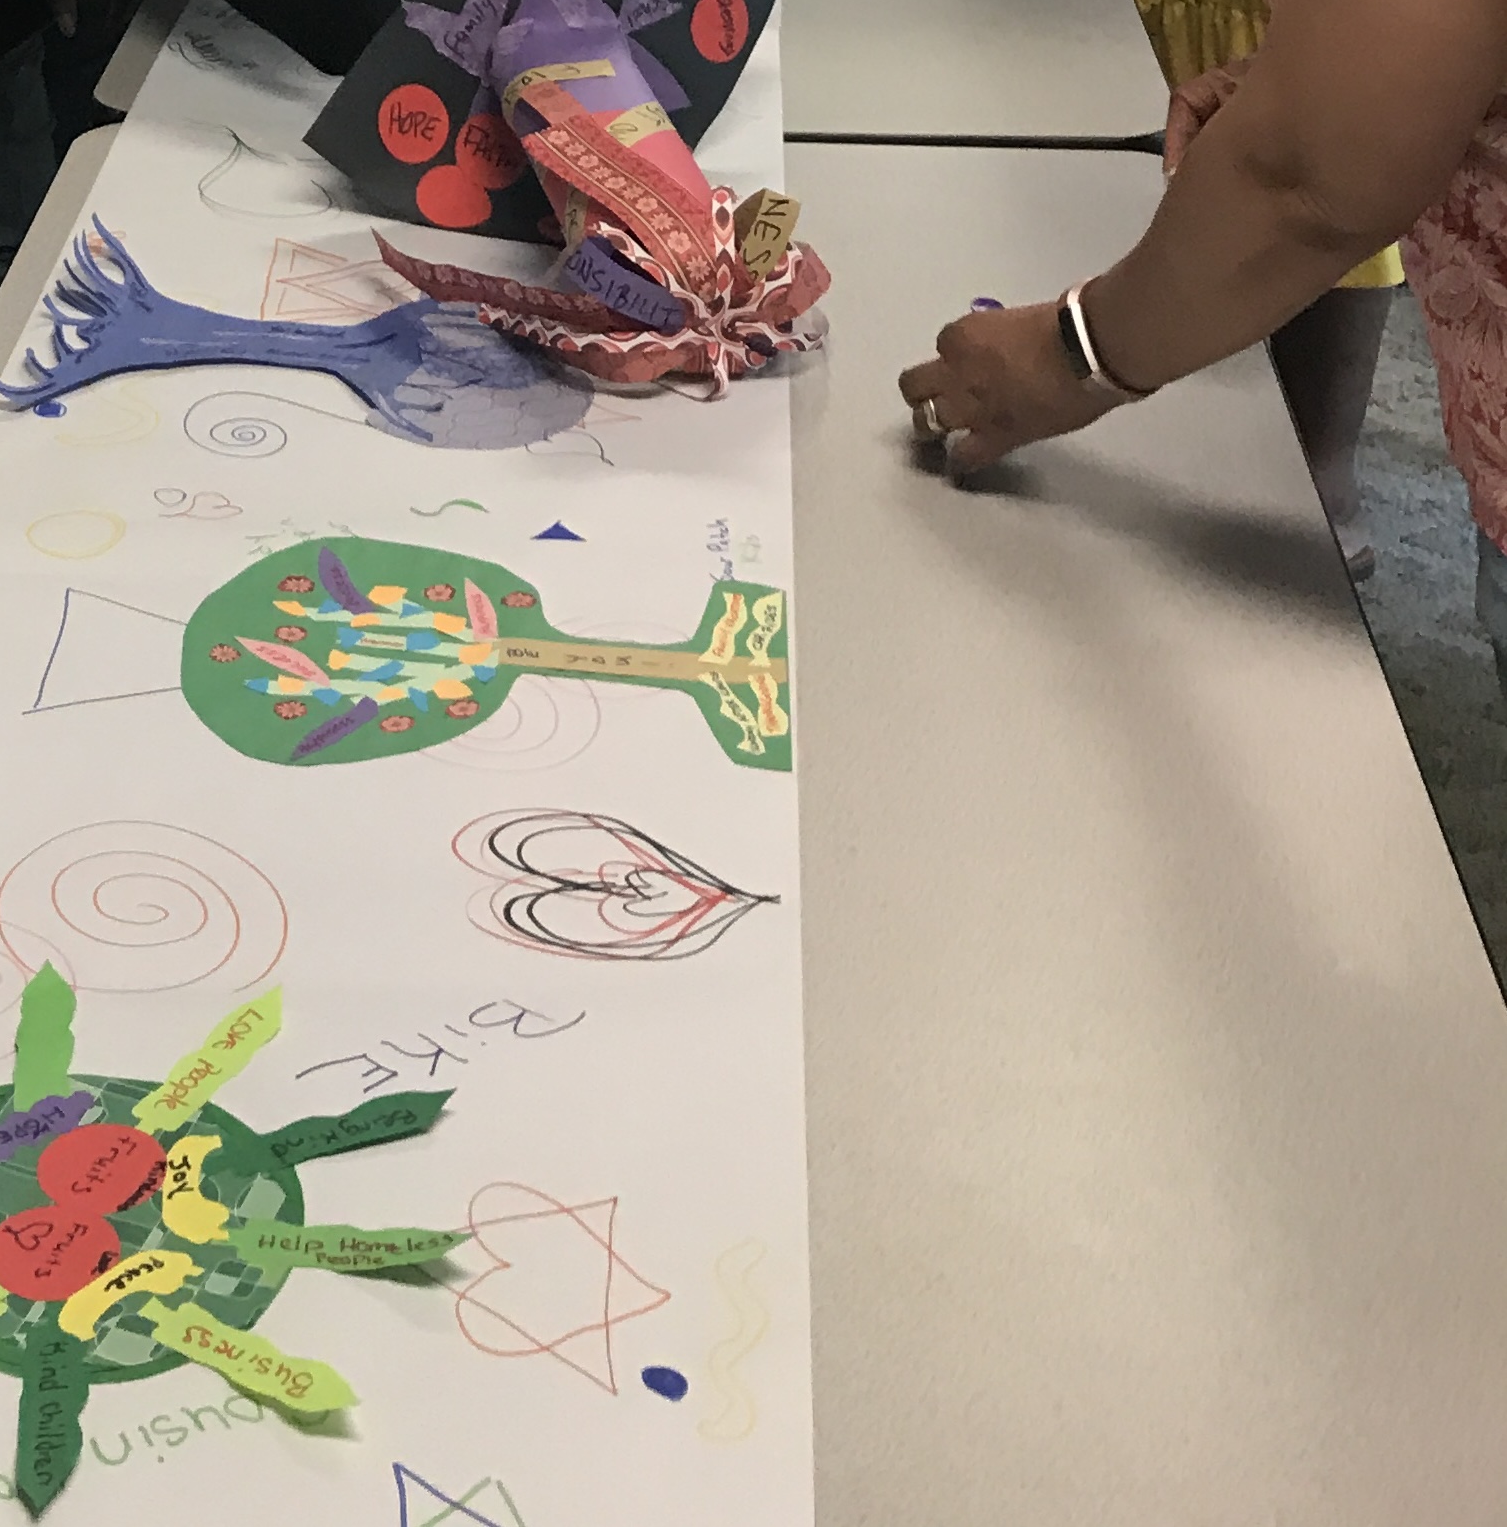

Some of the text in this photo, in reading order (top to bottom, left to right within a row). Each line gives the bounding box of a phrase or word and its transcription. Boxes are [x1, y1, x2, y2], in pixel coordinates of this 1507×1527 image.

[387, 100, 440, 142] HOPE
[257, 1231, 456, 1257] Help Homeless
[180, 1325, 316, 1400] Business
